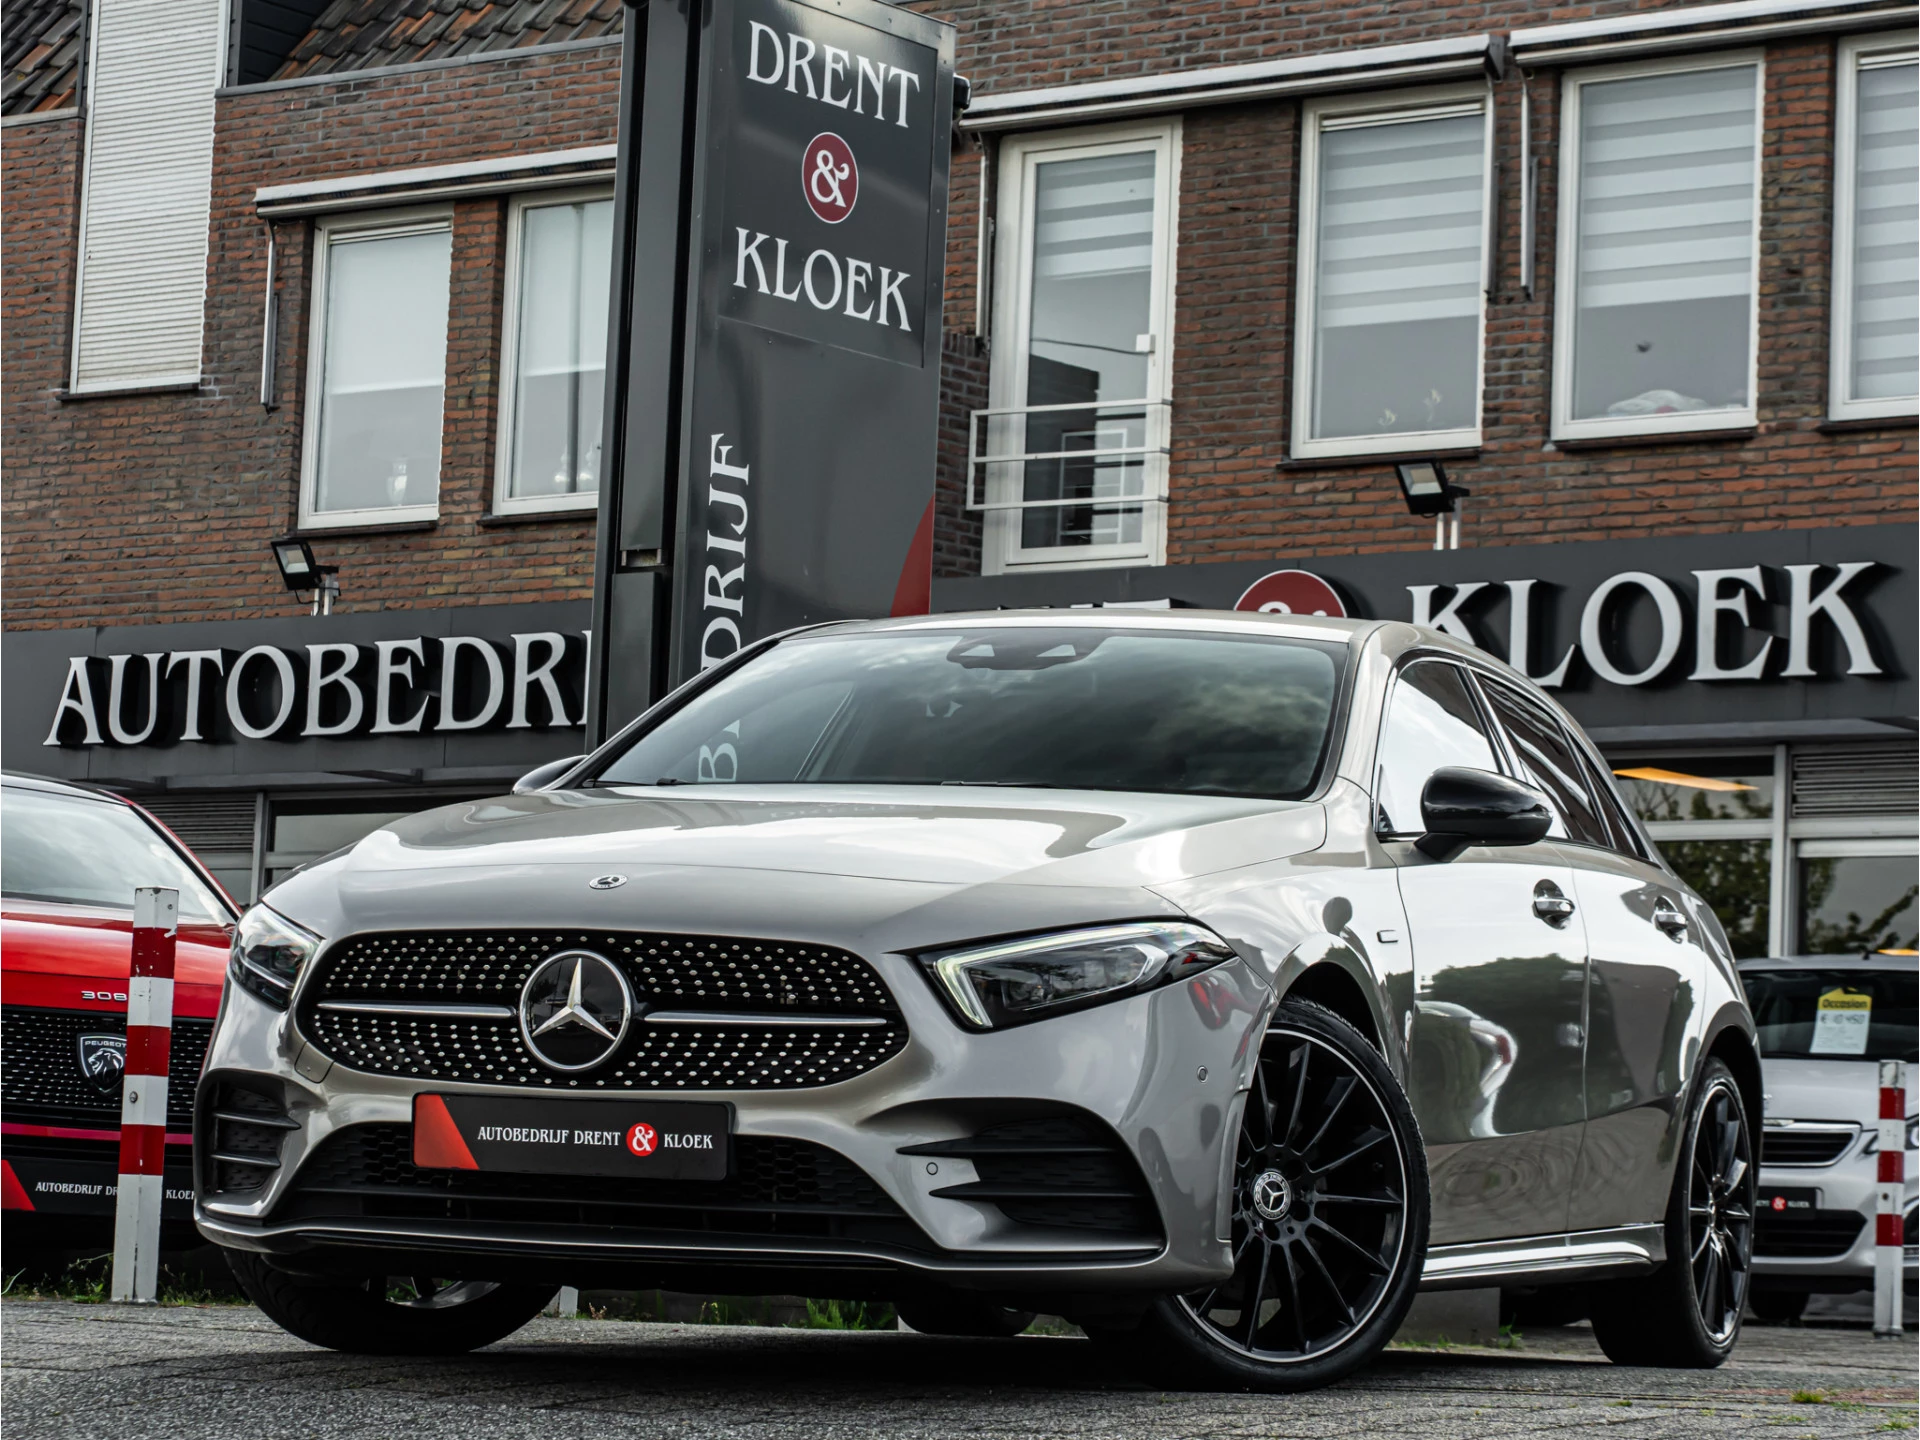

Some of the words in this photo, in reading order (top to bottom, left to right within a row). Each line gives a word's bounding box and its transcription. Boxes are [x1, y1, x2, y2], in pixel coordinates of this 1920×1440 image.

[746, 20, 920, 128] DRENT
[811, 149, 850, 208] &
[733, 226, 912, 332] KLOEK
[81, 990, 127, 1001] 308
[84, 1040, 127, 1048] PEUGEOT
[477, 1125, 570, 1145] AUTOBEDRIJF
[573, 1129, 621, 1146] DRENT
[632, 1125, 655, 1152] &
[663, 1132, 714, 1149] KLOEK
[35, 1181, 103, 1195] AUTOBEDRIJF
